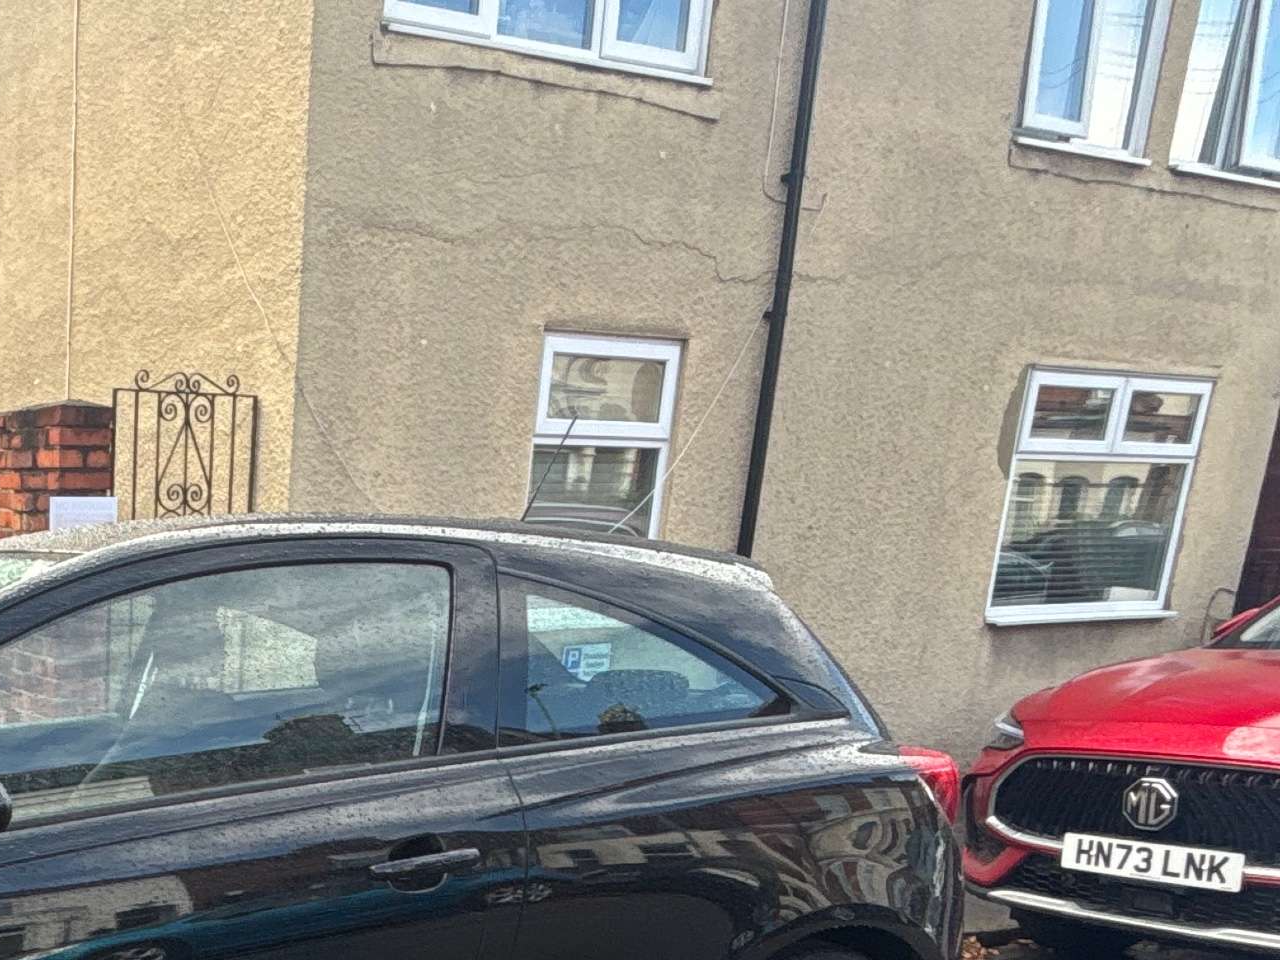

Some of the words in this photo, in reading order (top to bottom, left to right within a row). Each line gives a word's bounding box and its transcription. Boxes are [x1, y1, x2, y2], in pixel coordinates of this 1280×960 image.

[1126, 781, 1173, 826] MG
[1075, 838, 1153, 874] HN73
[1161, 849, 1230, 884] LNK
